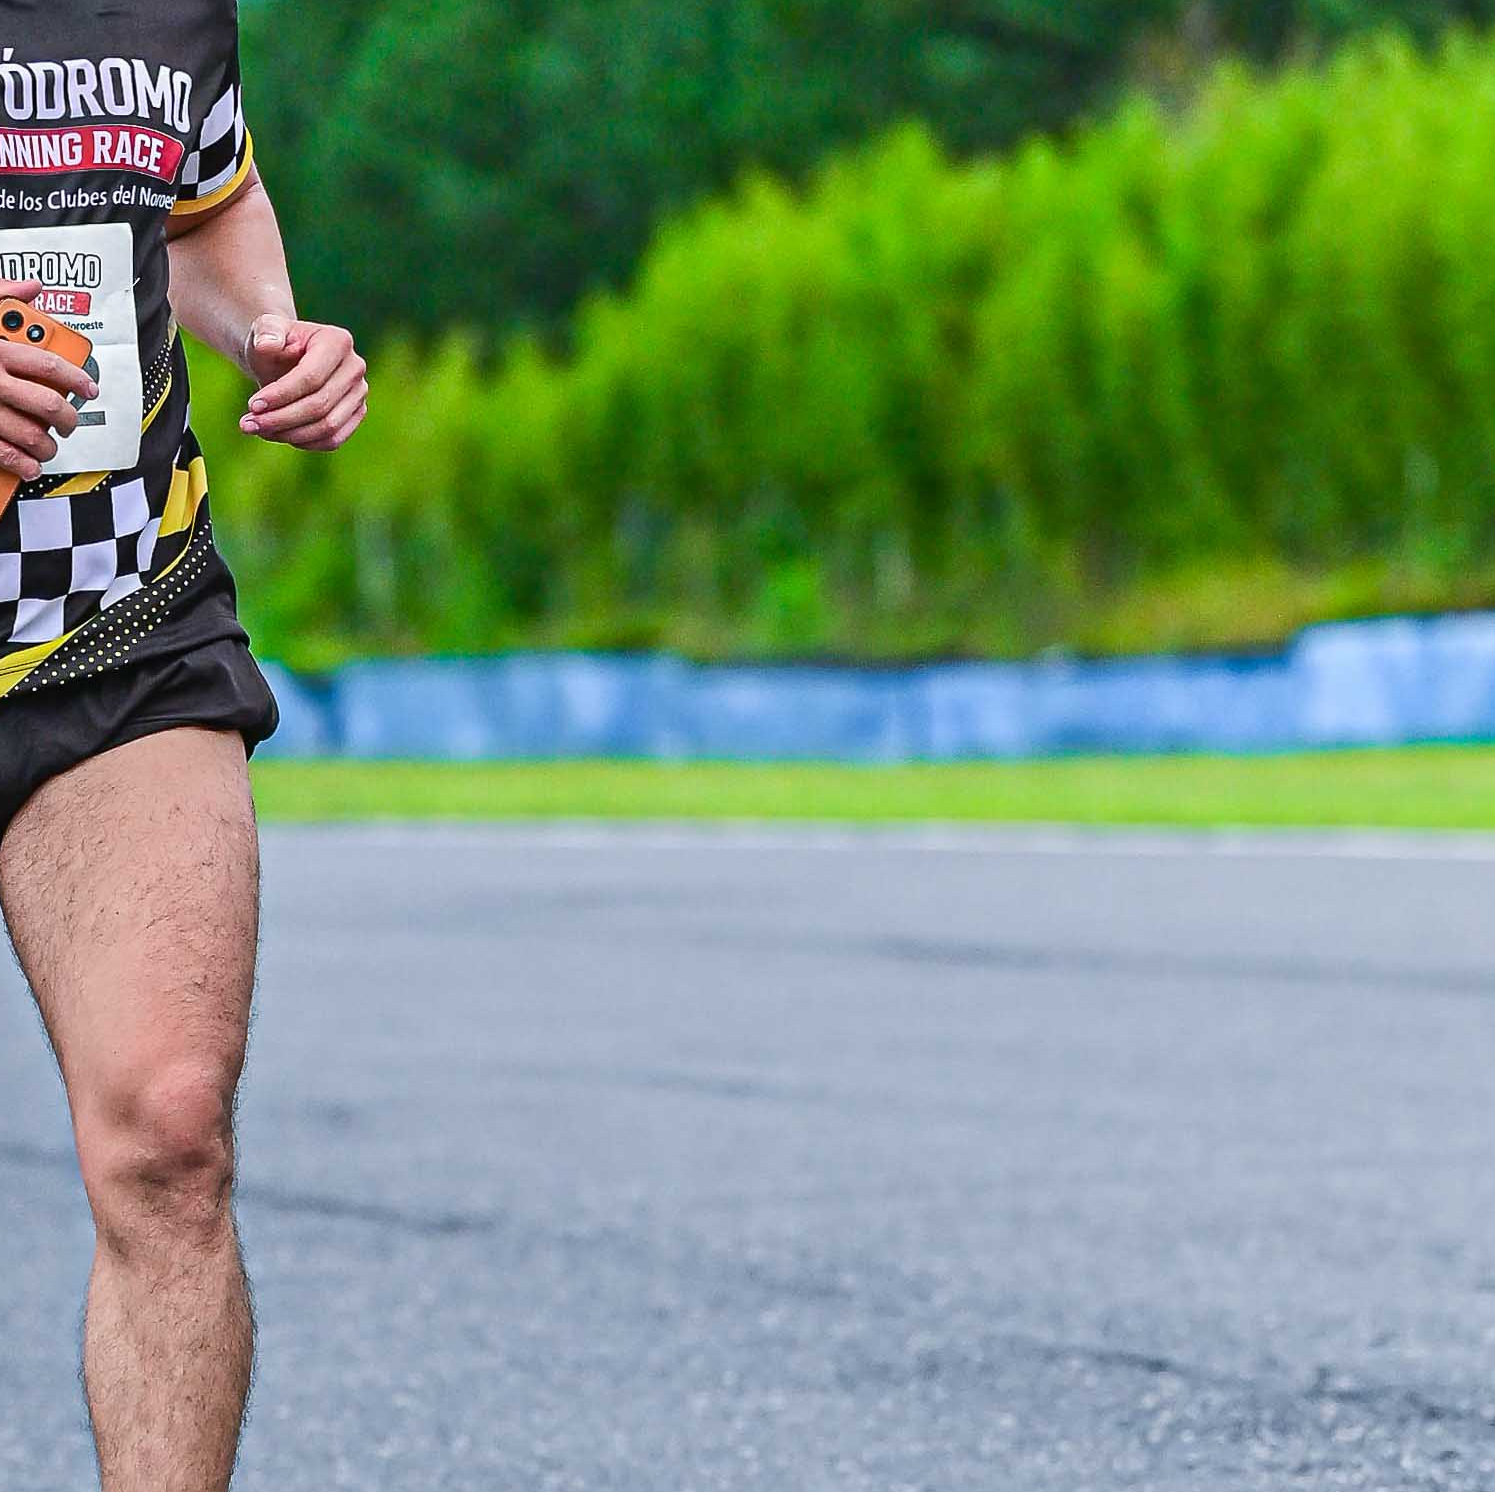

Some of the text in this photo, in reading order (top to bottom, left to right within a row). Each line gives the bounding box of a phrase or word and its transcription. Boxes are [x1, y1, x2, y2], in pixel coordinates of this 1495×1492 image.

[92, 130, 165, 173] RACE
[19, 190, 43, 211] los
[47, 187, 108, 210] Clubes
[112, 184, 137, 205] del
[35, 292, 76, 313] RACE
